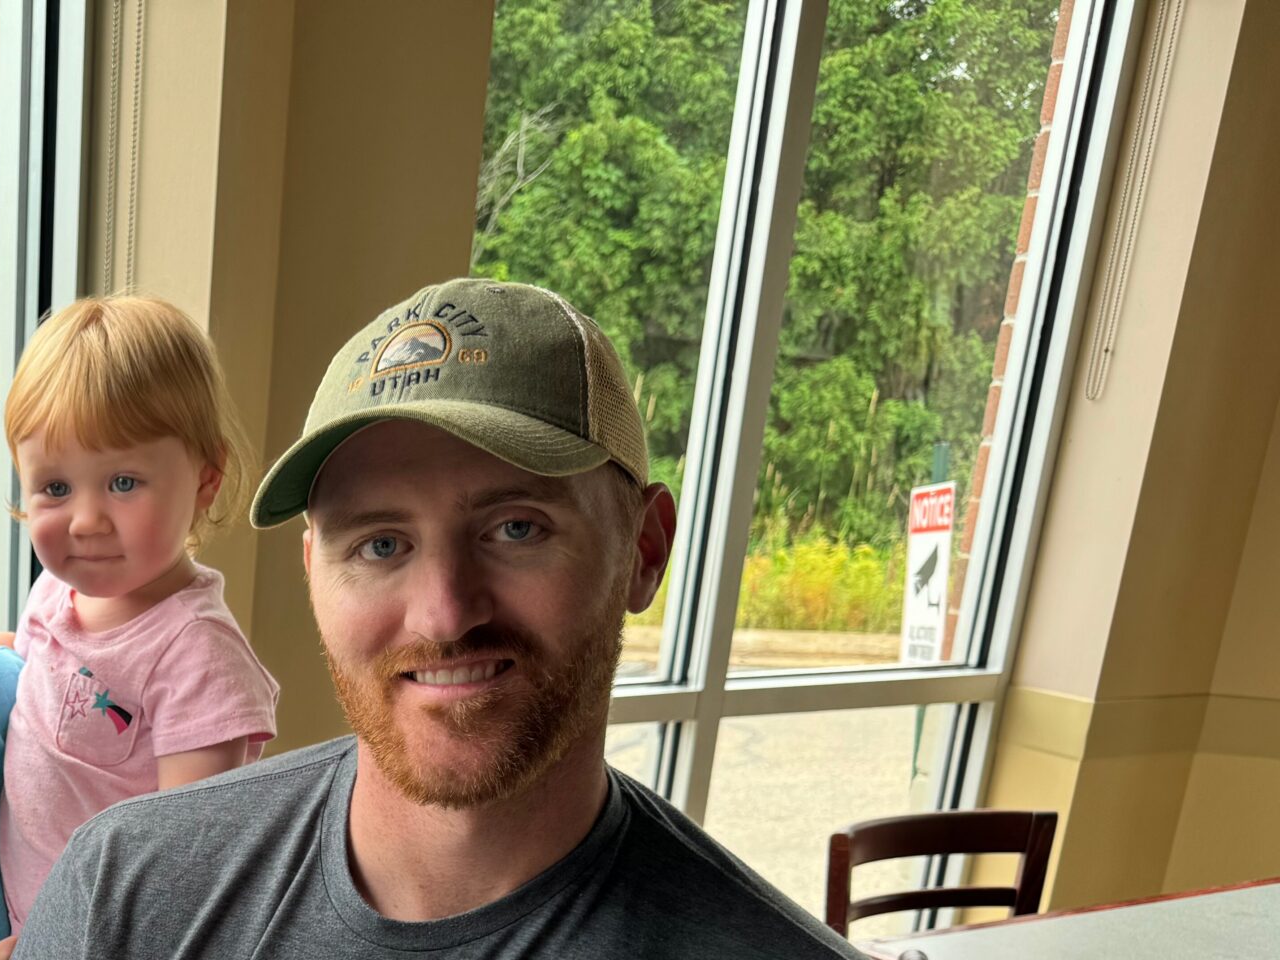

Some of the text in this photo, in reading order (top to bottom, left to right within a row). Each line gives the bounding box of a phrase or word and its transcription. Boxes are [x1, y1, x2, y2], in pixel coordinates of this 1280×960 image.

[355, 302, 489, 364] PARK CITY
[371, 366, 441, 398] UTAH
[911, 493, 952, 530] NOTICE
